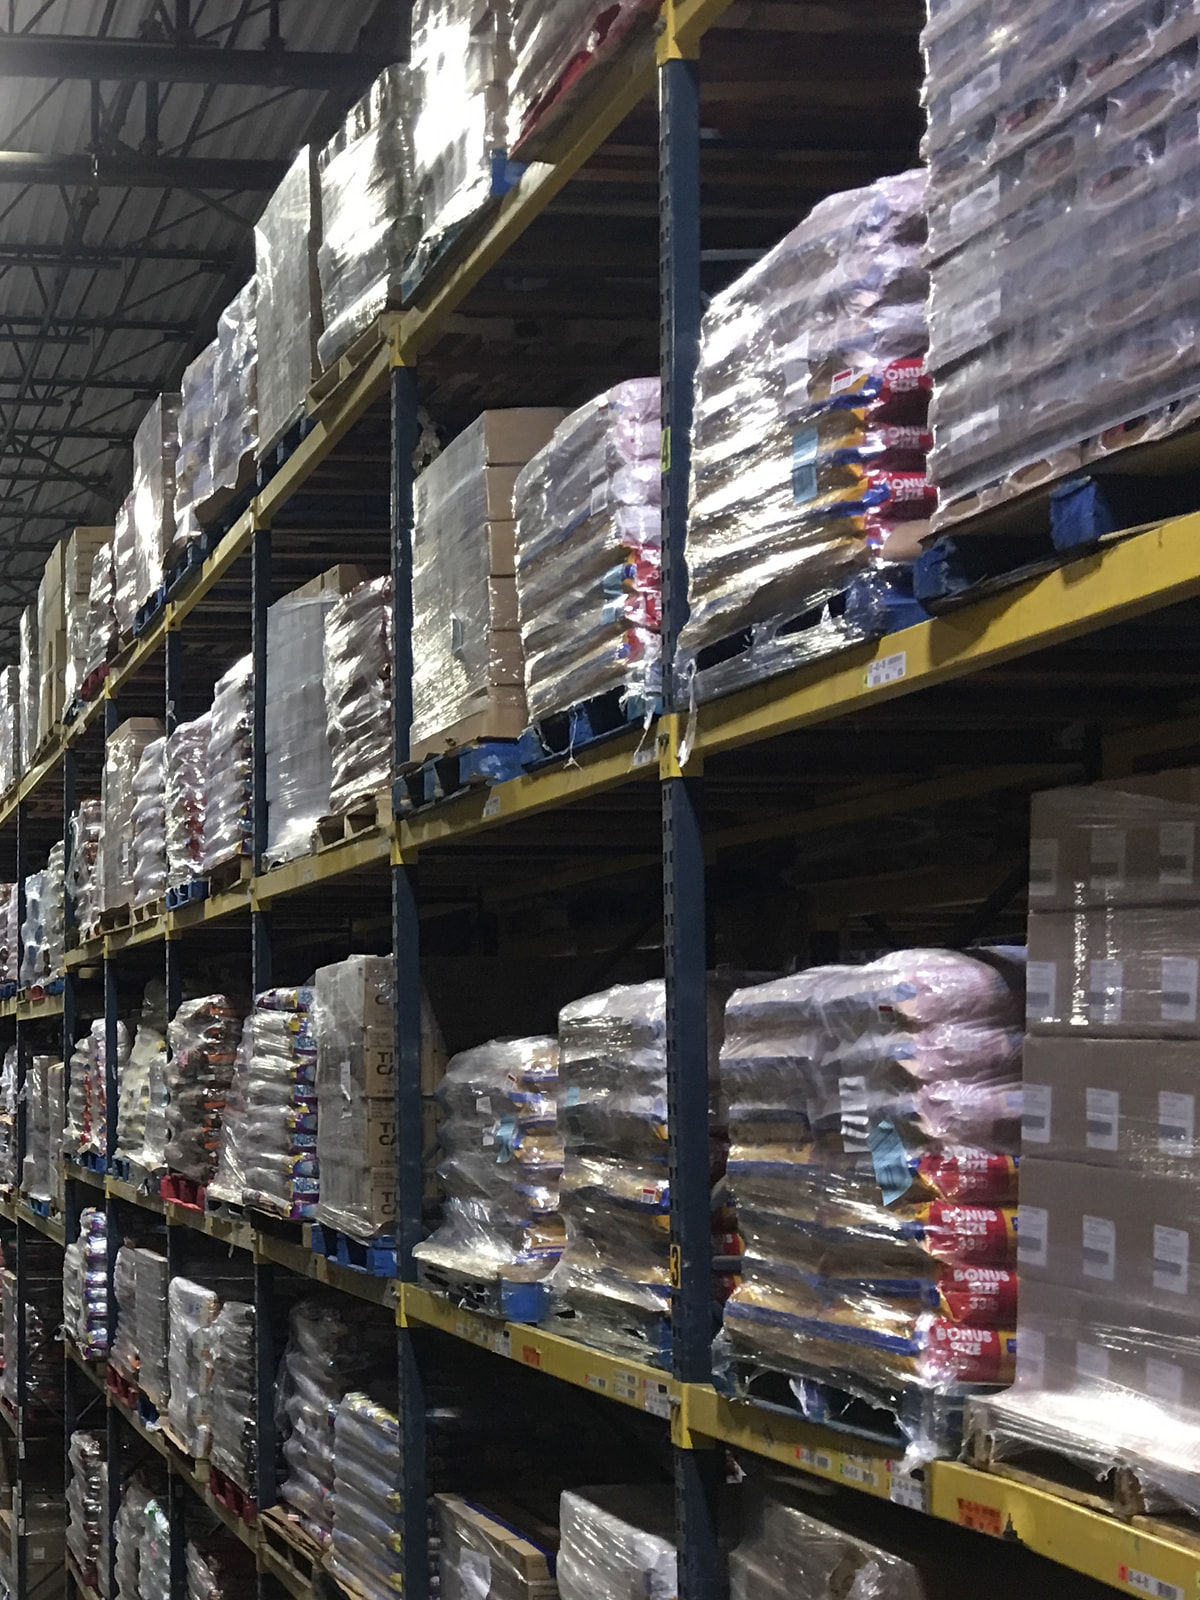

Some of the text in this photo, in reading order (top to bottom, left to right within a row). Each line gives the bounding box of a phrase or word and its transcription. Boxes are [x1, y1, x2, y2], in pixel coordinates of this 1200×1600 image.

[661, 429, 670, 469] 4
[895, 487, 925, 503] SIZE
[957, 1159, 988, 1174] SIZE
[940, 1209, 998, 1223] BONUS
[954, 1222, 987, 1236] SIZE
[671, 1246, 679, 1288] 3
[953, 1268, 1010, 1283] BONUS
[967, 1281, 1000, 1295] SIZE
[968, 1296, 999, 1311] 33lb
[935, 1327, 993, 1343] BONUS
[949, 1341, 982, 1356] SIZE
